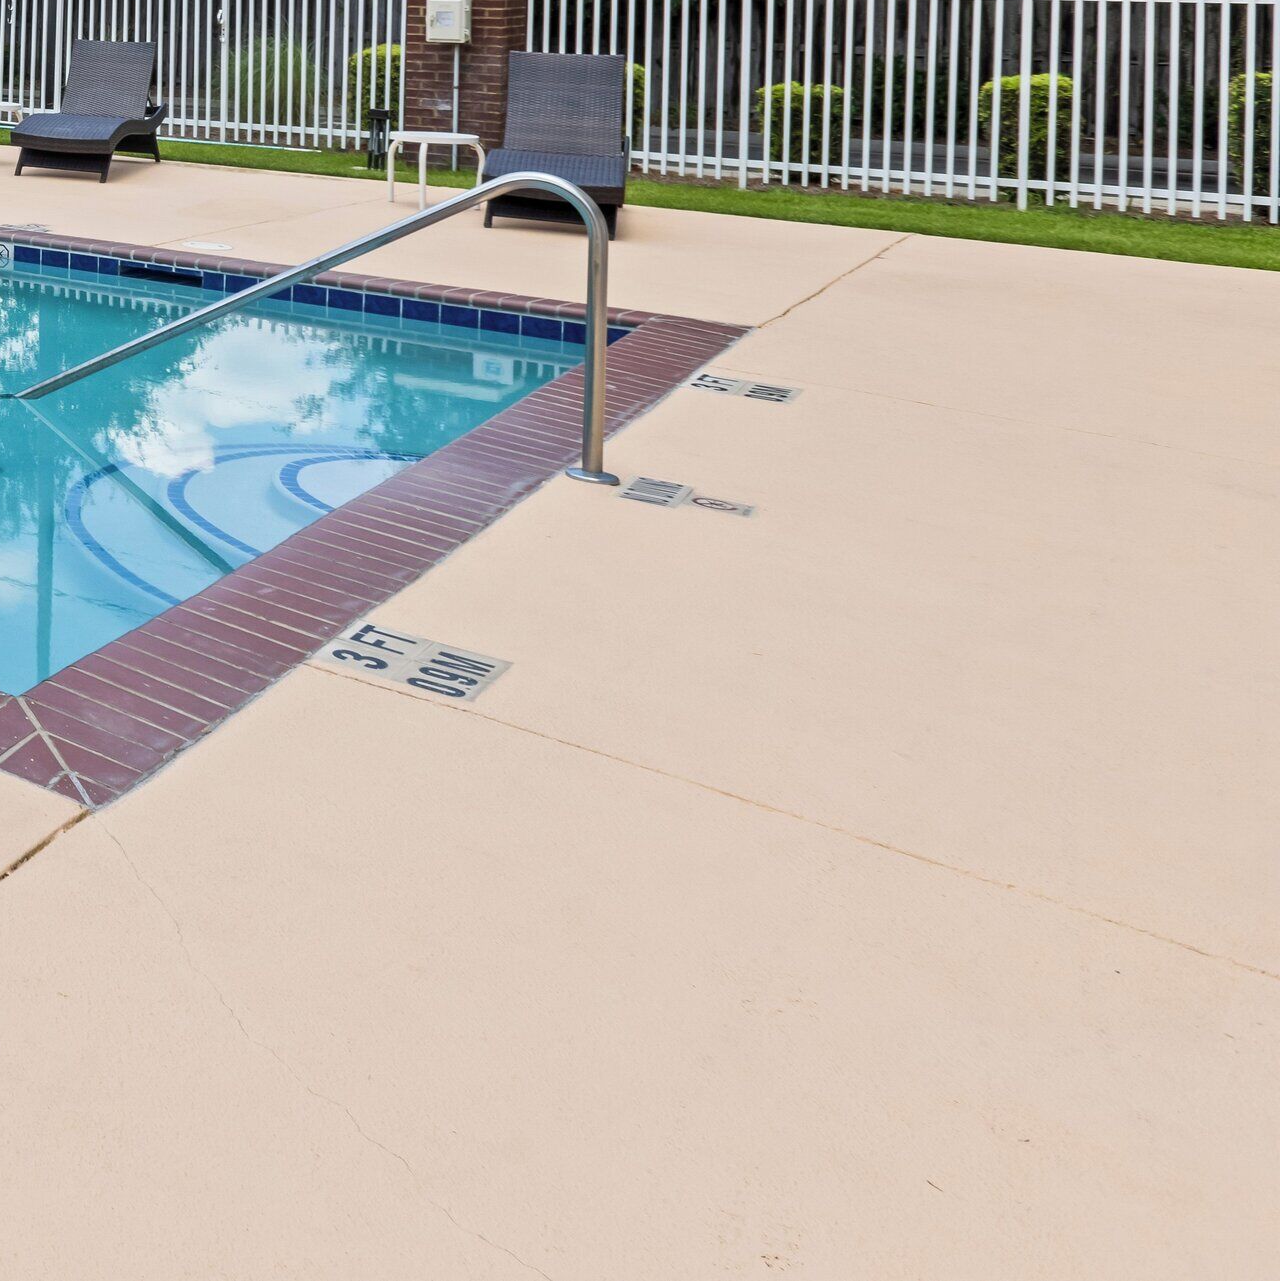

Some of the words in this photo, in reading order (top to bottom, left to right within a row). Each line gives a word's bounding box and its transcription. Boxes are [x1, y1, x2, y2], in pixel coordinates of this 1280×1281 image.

[691, 382, 728, 391] 3
[697, 374, 739, 387] FT
[349, 624, 417, 655] FT
[332, 649, 389, 670] 3
